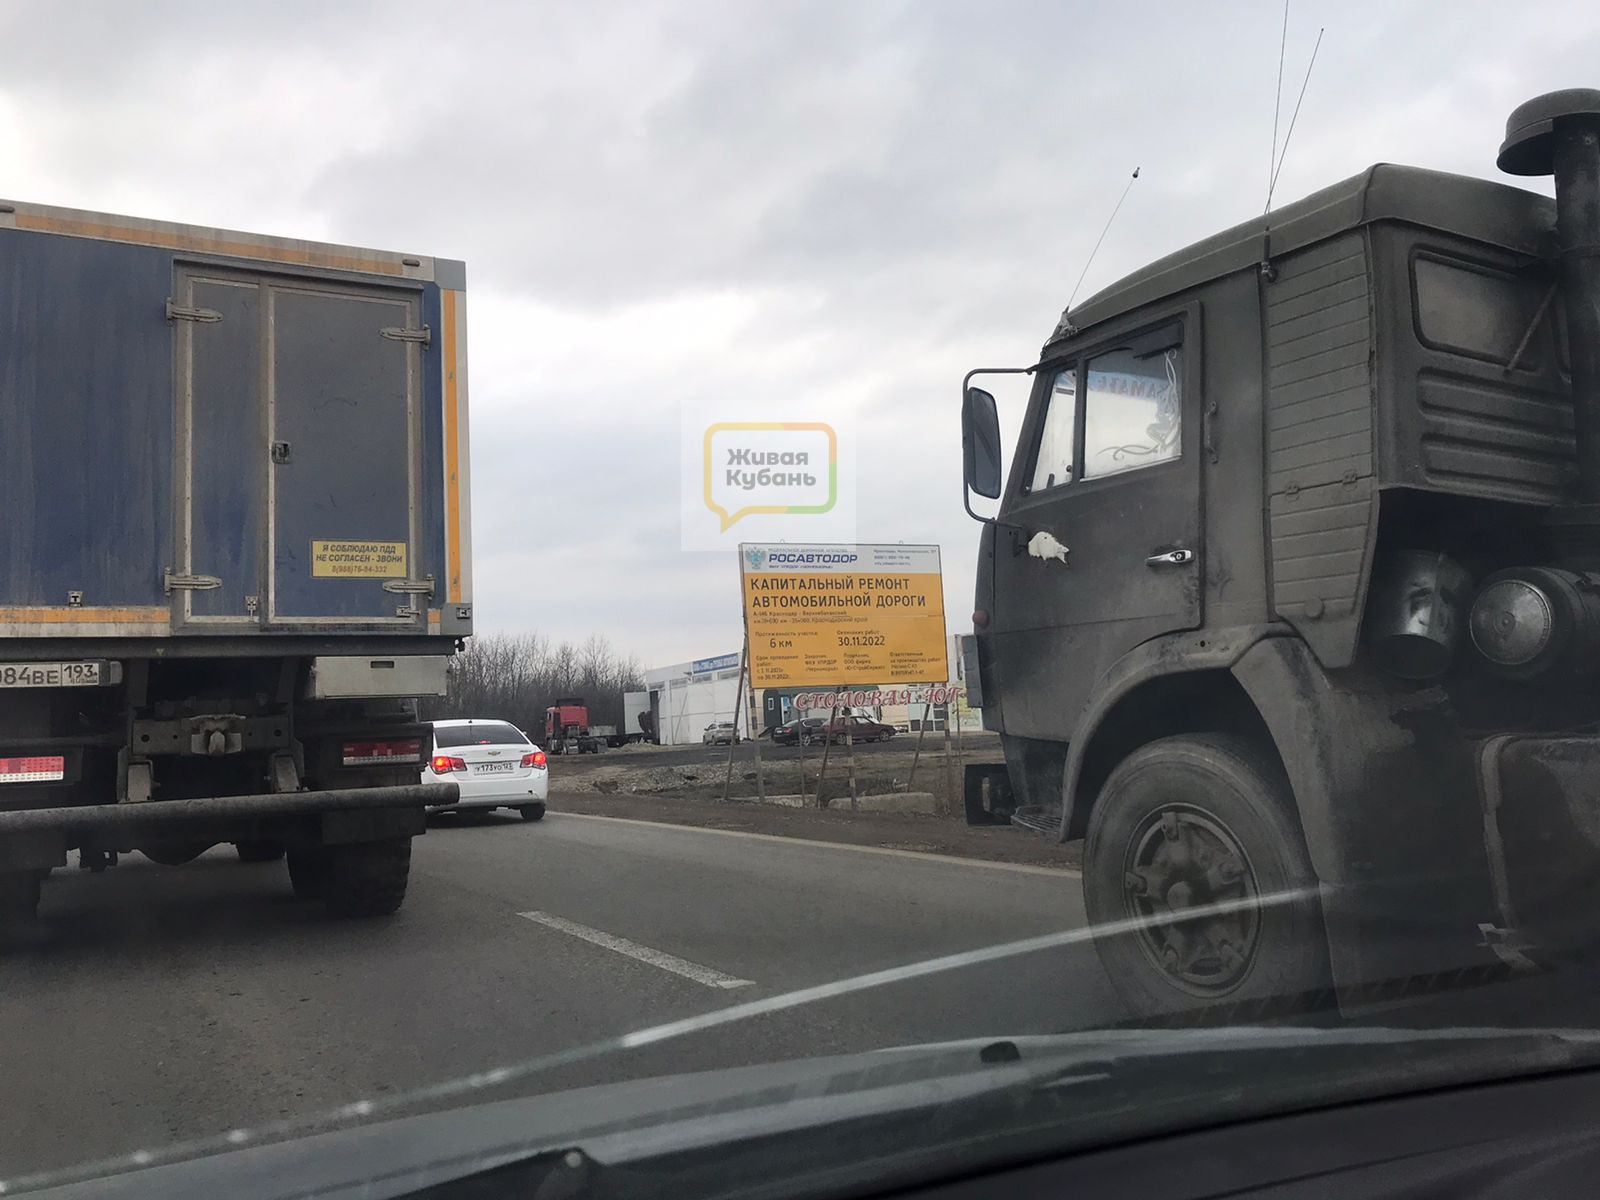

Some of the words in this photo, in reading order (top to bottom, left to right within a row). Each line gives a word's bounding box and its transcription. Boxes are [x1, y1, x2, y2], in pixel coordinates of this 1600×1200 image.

[330, 544, 379, 554] СОБЛЮДАЮ
[380, 546, 397, 555] ПДД
[316, 554, 327, 562] НЕ
[329, 554, 371, 562] СОГЛАСЕН
[376, 555, 403, 563] ЗВОНИ
[768, 553, 858, 564] РОСАВТОДОР
[750, 575, 854, 591] КАПИТАЛЬНЫЙ
[859, 578, 910, 590] РЕМОНТ
[752, 591, 871, 608] АВТОМОБИЛЬНОЙ
[875, 595, 926, 608] ДОРОГИ
[769, 638, 777, 648] 6
[778, 640, 793, 648] км
[837, 636, 886, 647] 30.11.2022
[0, 667, 58, 685] 84ВЕ
[63, 664, 94, 679] 193
[794, 689, 912, 710] СТОЛОВАЯ
